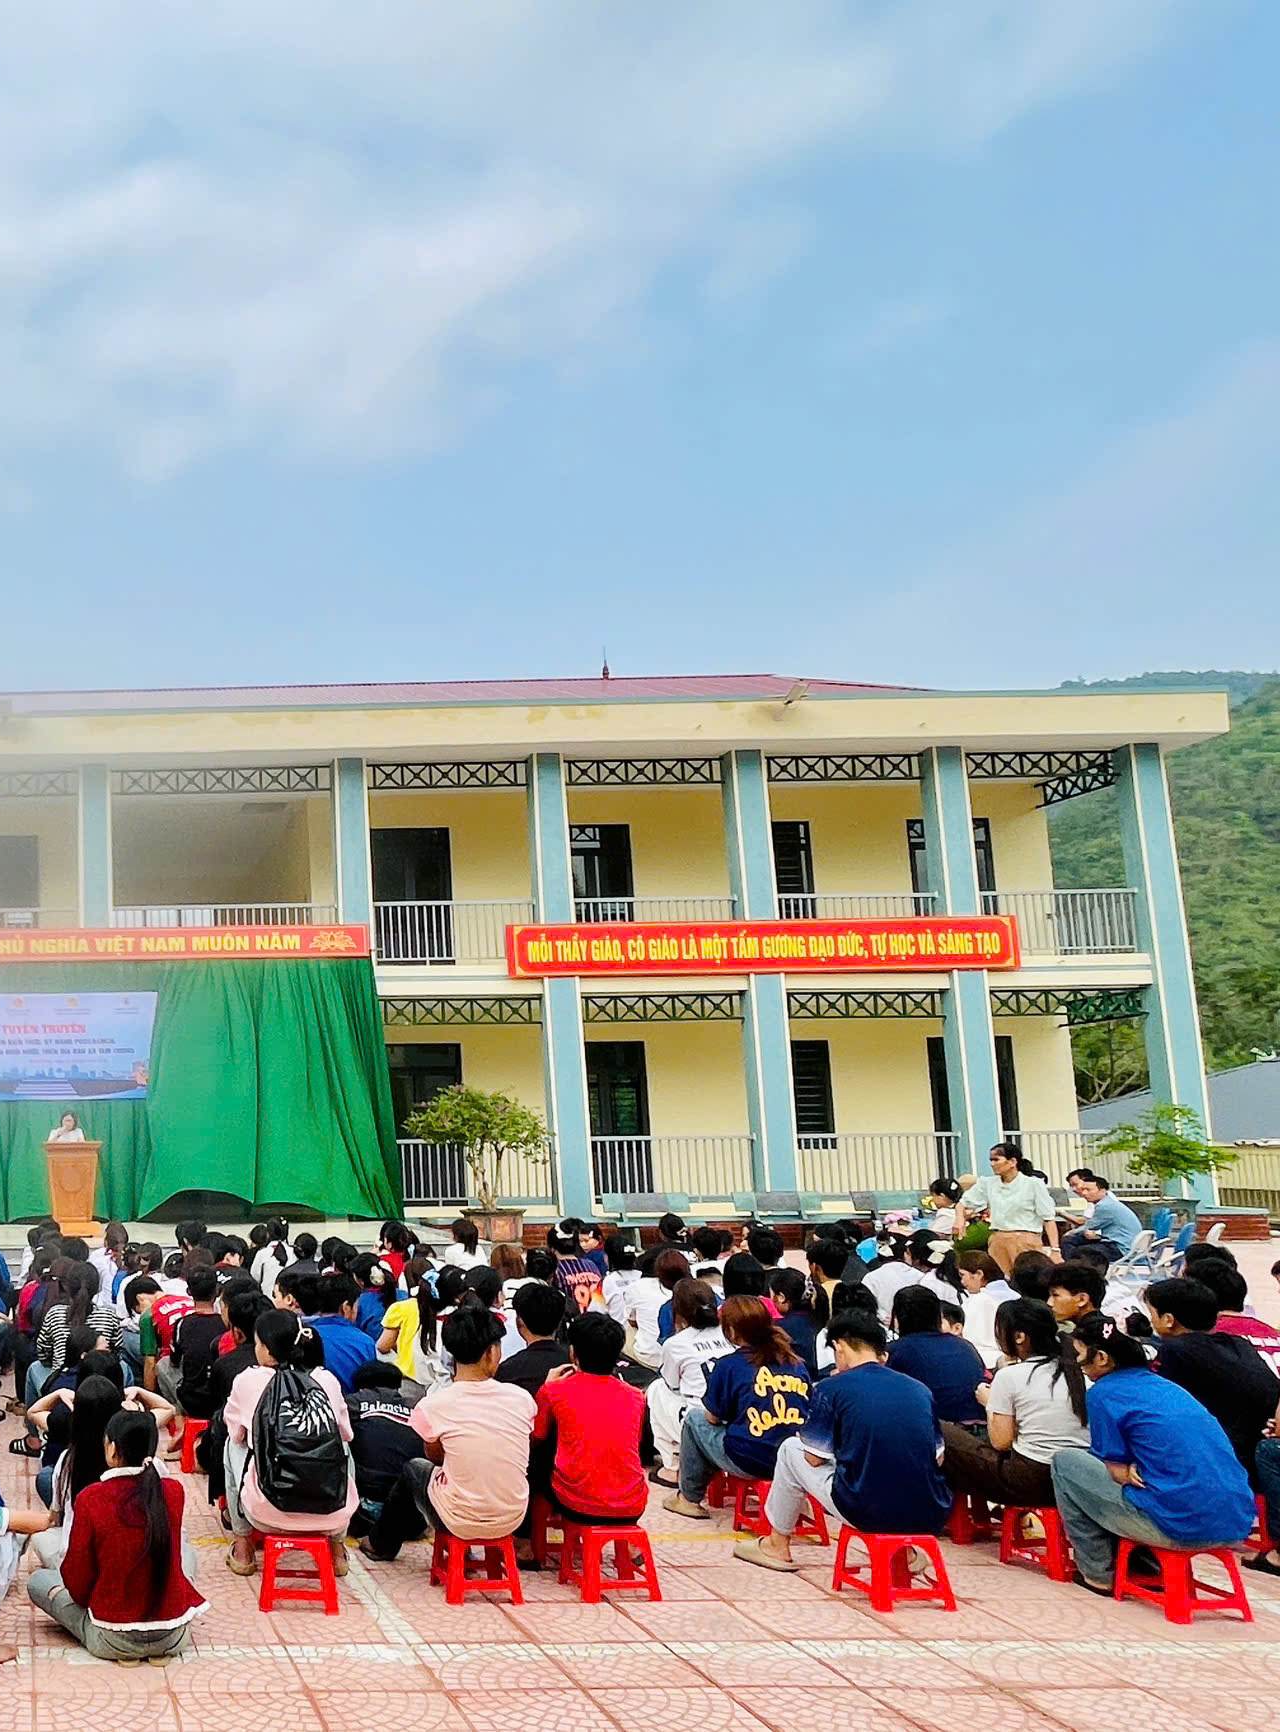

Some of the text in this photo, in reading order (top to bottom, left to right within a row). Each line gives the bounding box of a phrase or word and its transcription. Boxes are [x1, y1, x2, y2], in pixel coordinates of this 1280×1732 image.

[95, 935, 135, 955] VIỆT
[141, 936, 185, 952] NAM
[192, 935, 249, 951] MUÔN
[255, 932, 301, 951] NĂM
[556, 932, 587, 962] THẦY
[591, 935, 624, 963] GIÁO,
[628, 935, 645, 960] CÔ
[648, 934, 678, 959] GIÁO
[681, 934, 699, 959] LÀ
[701, 933, 727, 964] MỘT
[763, 932, 806, 958] GƯƠNG
[808, 935, 835, 961] ĐẠO
[838, 930, 869, 958] ĐỨC,
[870, 932, 888, 960] TỰ
[889, 933, 916, 960] HỌC
[918, 929, 937, 955] VÀ
[938, 929, 972, 955] SÁNG
[975, 932, 1001, 959] TẠO
